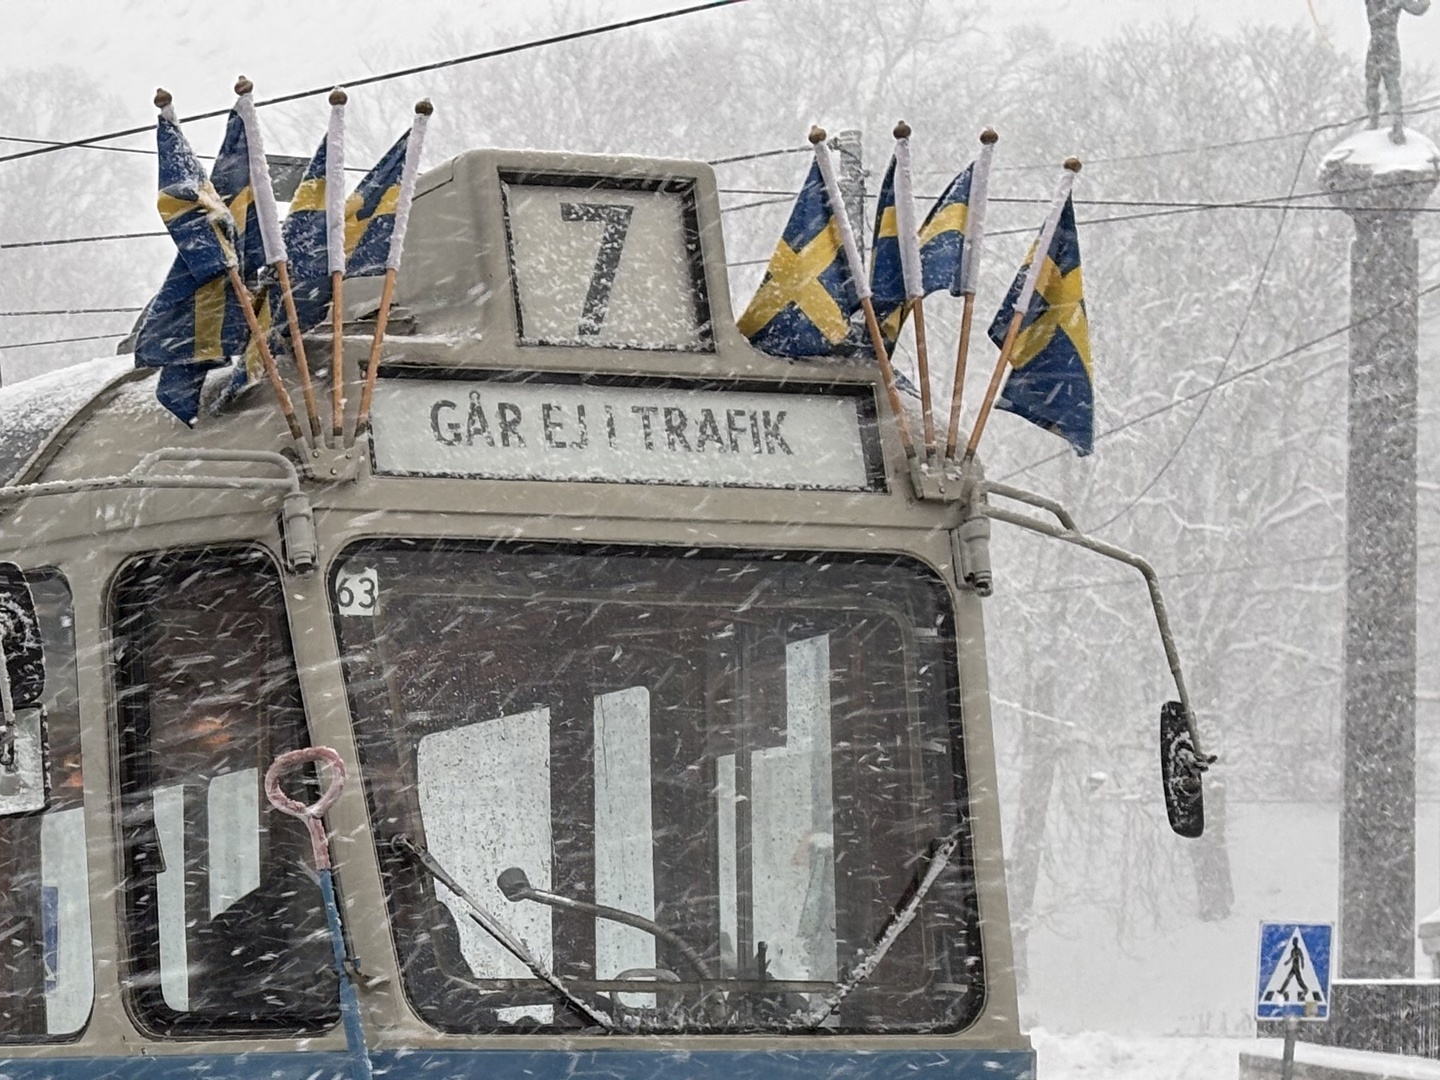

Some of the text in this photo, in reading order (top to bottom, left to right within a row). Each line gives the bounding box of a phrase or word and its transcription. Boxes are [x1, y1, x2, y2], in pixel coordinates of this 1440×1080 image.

[560, 202, 635, 336] 7
[429, 390, 793, 455] GÅR EJ I TRAFIK
[337, 577, 375, 609] 63
